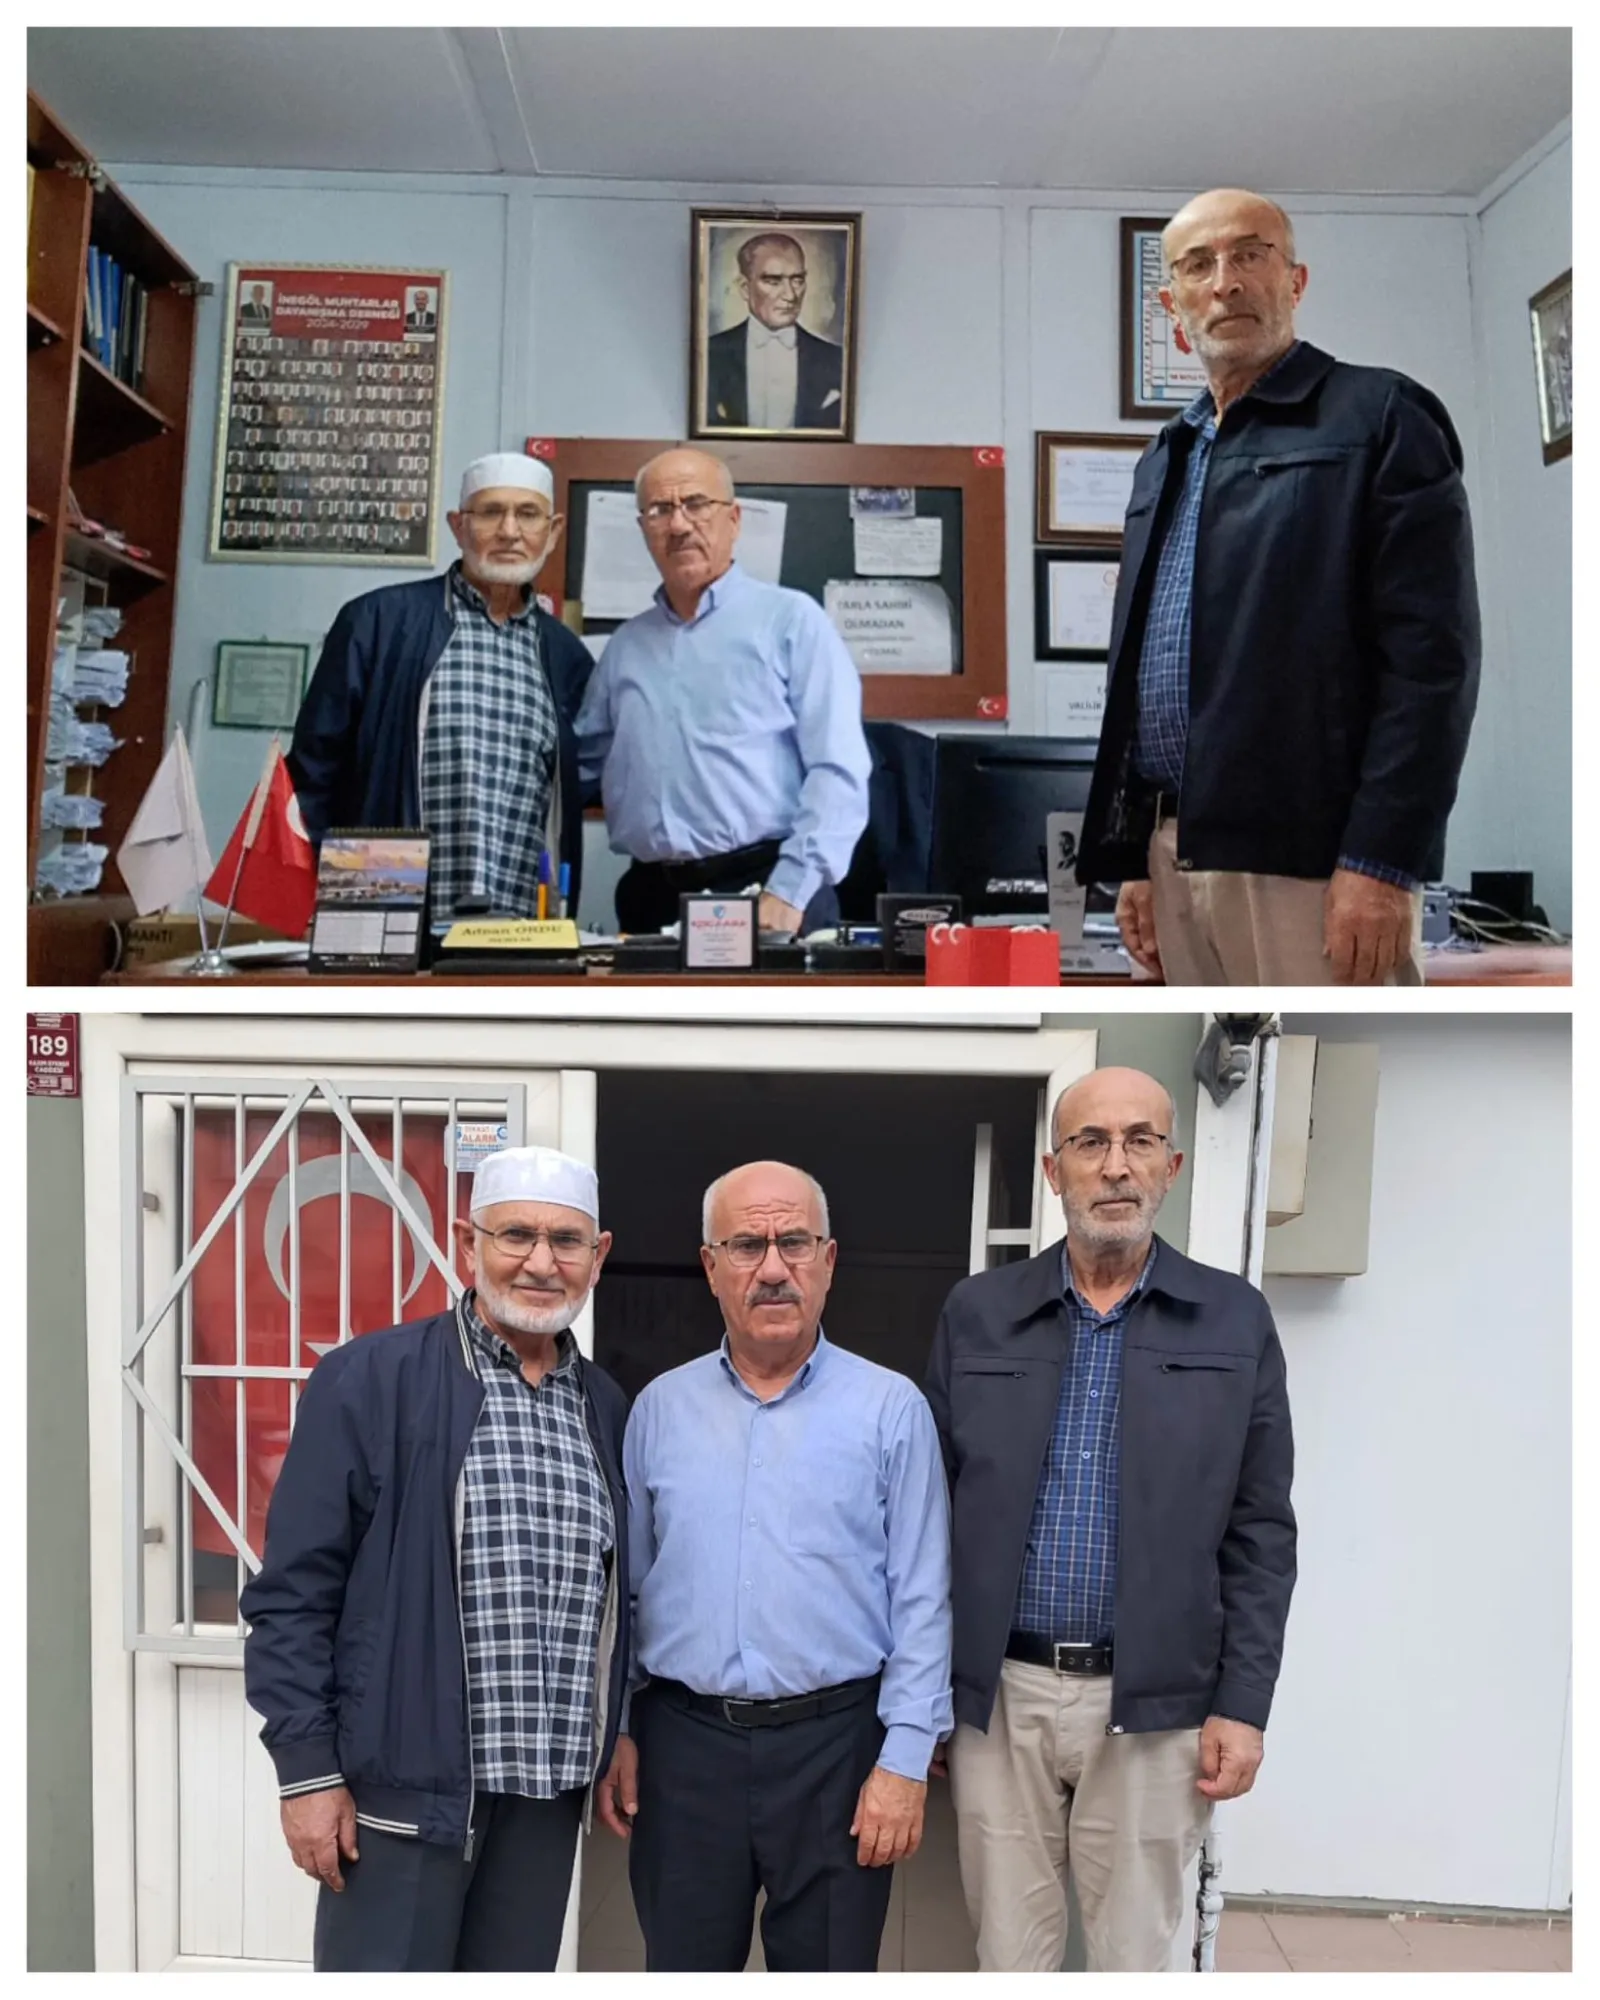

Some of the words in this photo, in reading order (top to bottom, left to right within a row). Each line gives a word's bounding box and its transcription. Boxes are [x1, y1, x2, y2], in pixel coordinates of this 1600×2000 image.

[324, 296, 399, 308] MUHTARLAR
[275, 306, 346, 318] DAYANIŞMA
[349, 306, 400, 319] DERNEĞİ
[29, 1034, 68, 1057] 189
[462, 1133, 498, 1142] ALARM
